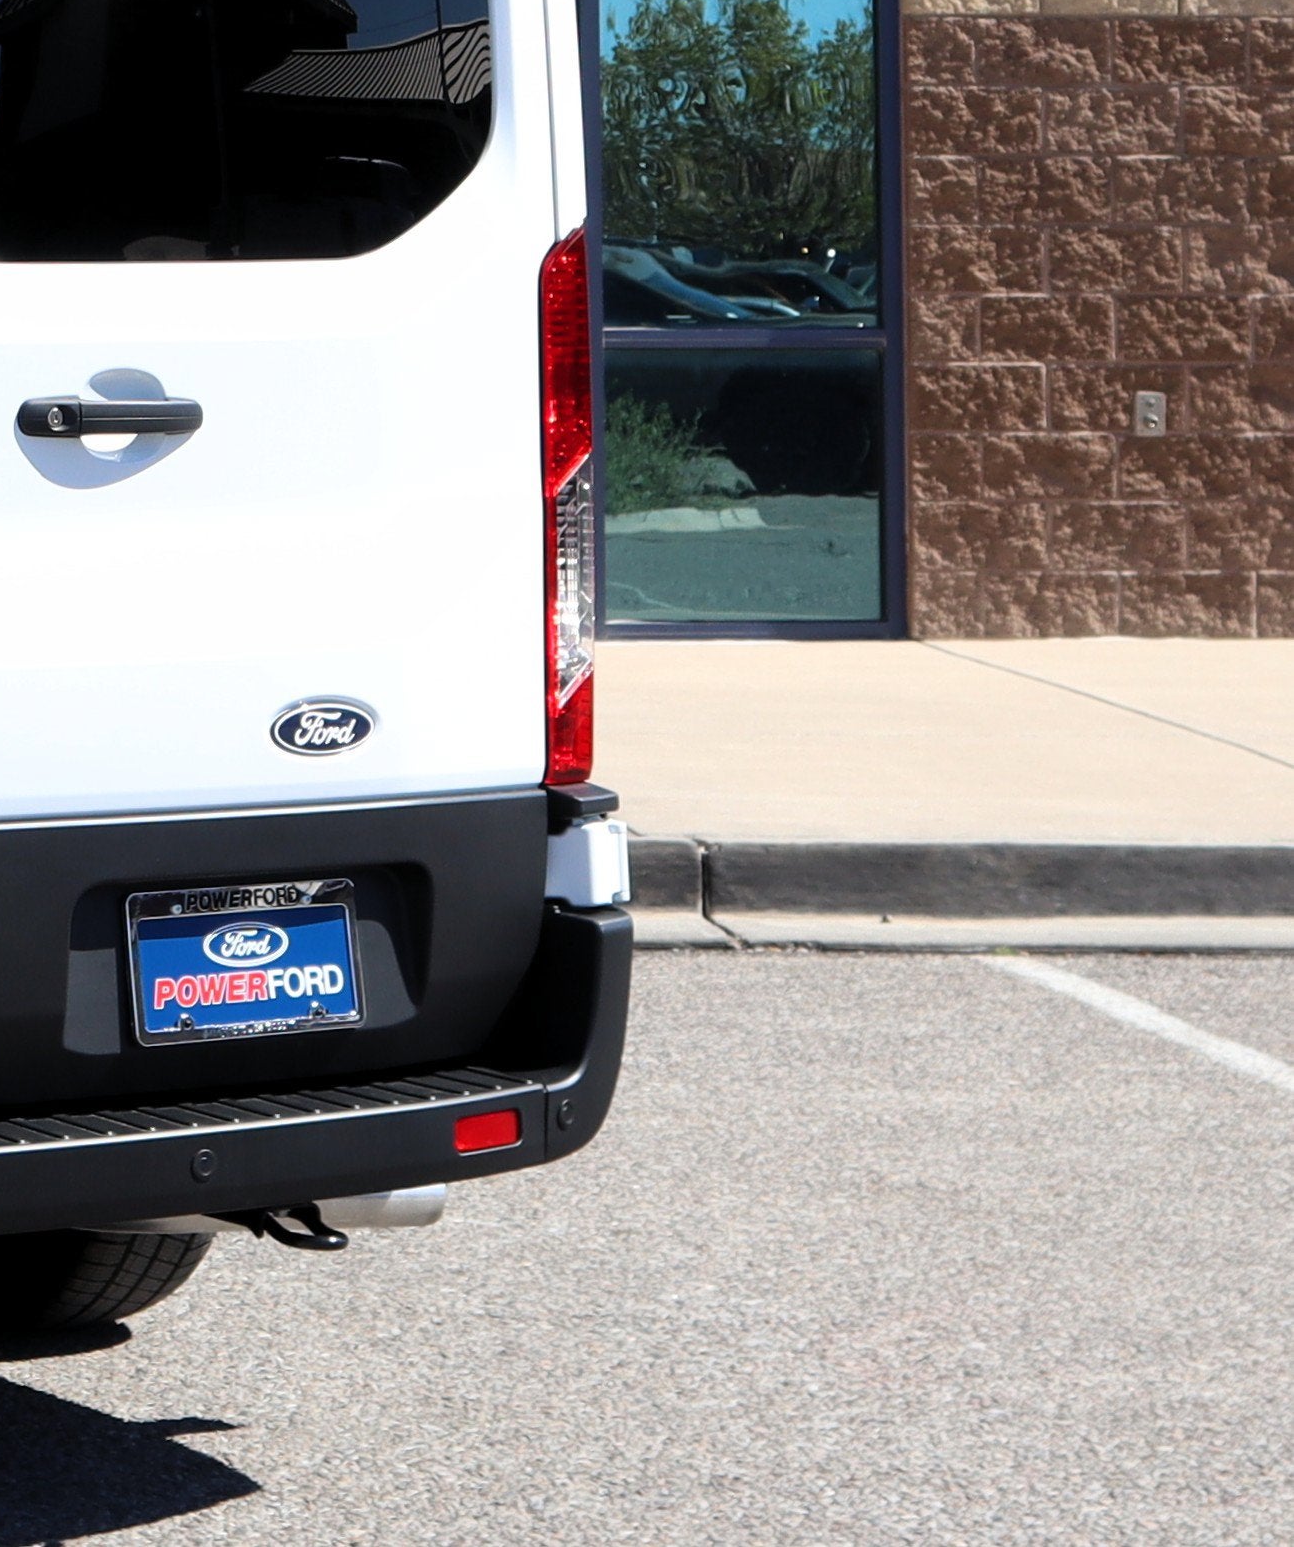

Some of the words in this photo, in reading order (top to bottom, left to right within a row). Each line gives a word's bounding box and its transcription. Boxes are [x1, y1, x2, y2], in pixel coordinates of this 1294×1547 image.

[294, 711, 357, 746] Ford
[184, 885, 301, 913] POWERFORD
[220, 929, 272, 956] Ford
[153, 963, 345, 1011] POWERFORD
